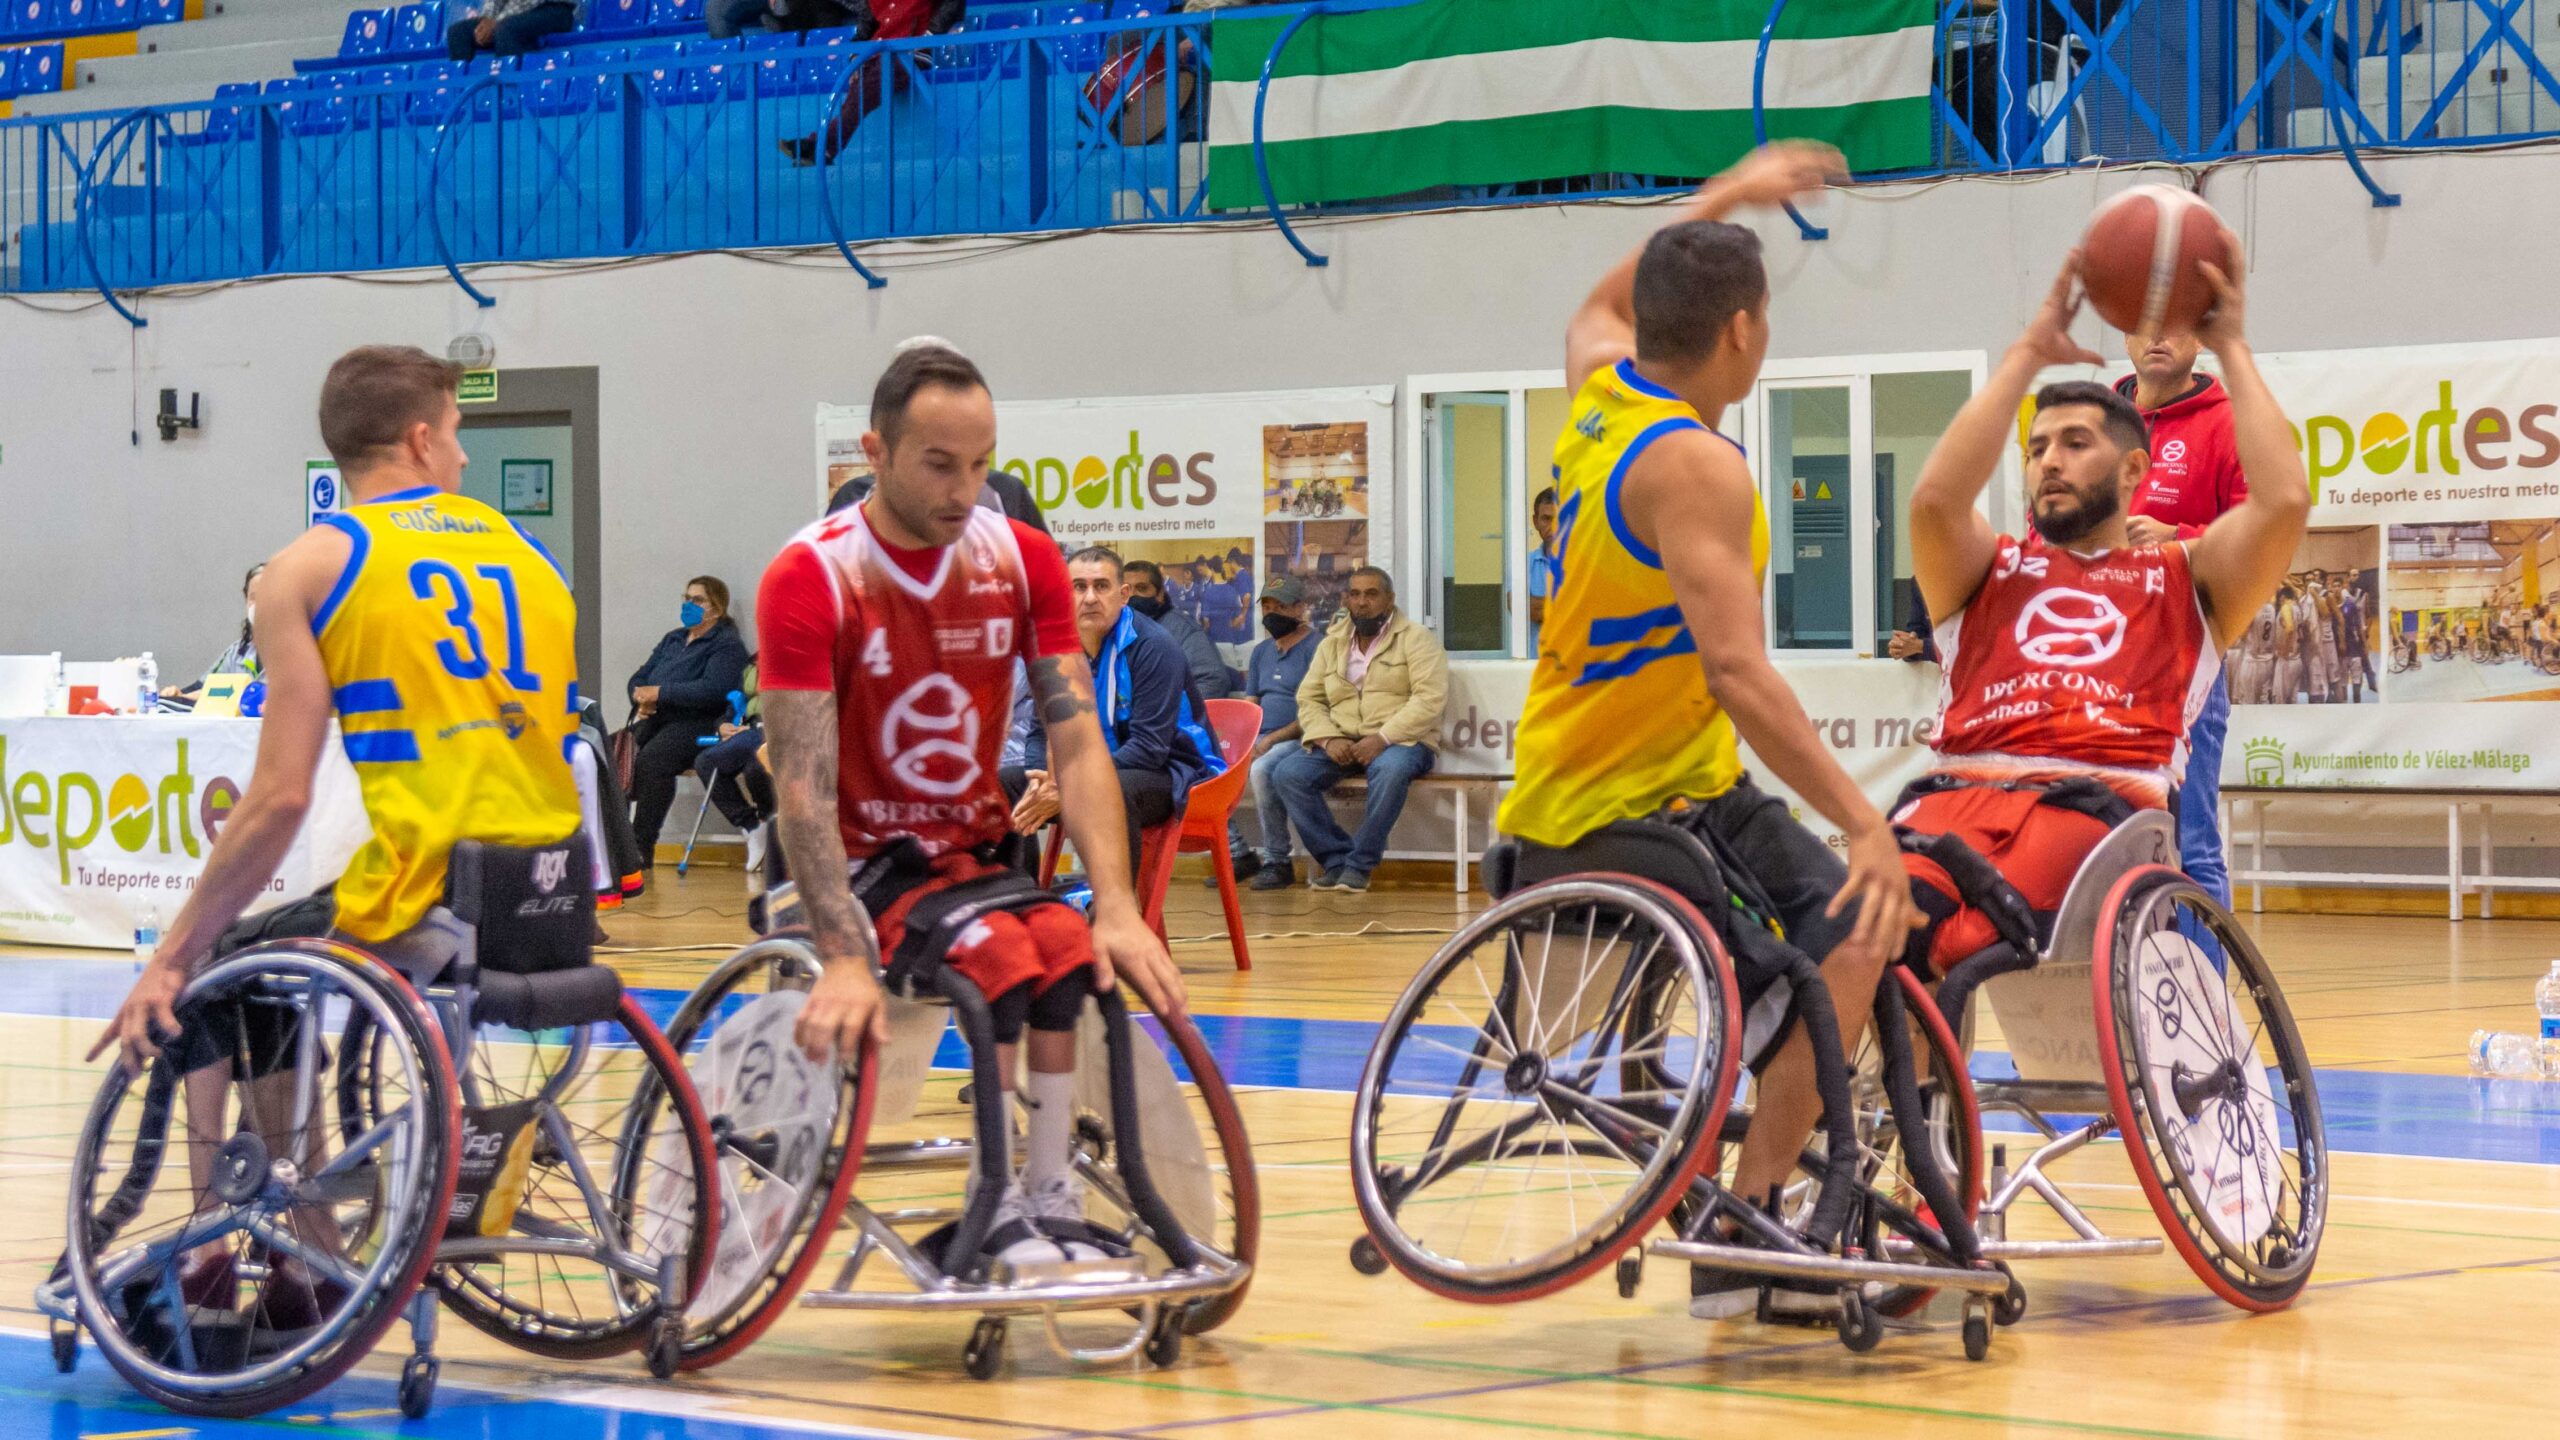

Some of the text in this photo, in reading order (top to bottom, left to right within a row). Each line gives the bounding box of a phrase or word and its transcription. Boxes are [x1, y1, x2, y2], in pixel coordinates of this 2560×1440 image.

[2288, 380, 2560, 506] portes
[2328, 482, 2559, 506] Tu deporte es nuestra meta
[1051, 518, 1216, 537] Tu deporte es nuestra meta
[408, 557, 542, 692] 31
[863, 626, 892, 676] 4
[2293, 749, 2530, 773] Ayuntamiento de Vélez-Málaga
[78, 866, 92, 885] Tu
[97, 867, 160, 892] deporte
[165, 874, 182, 889] es
[517, 895, 579, 916] ELITE
